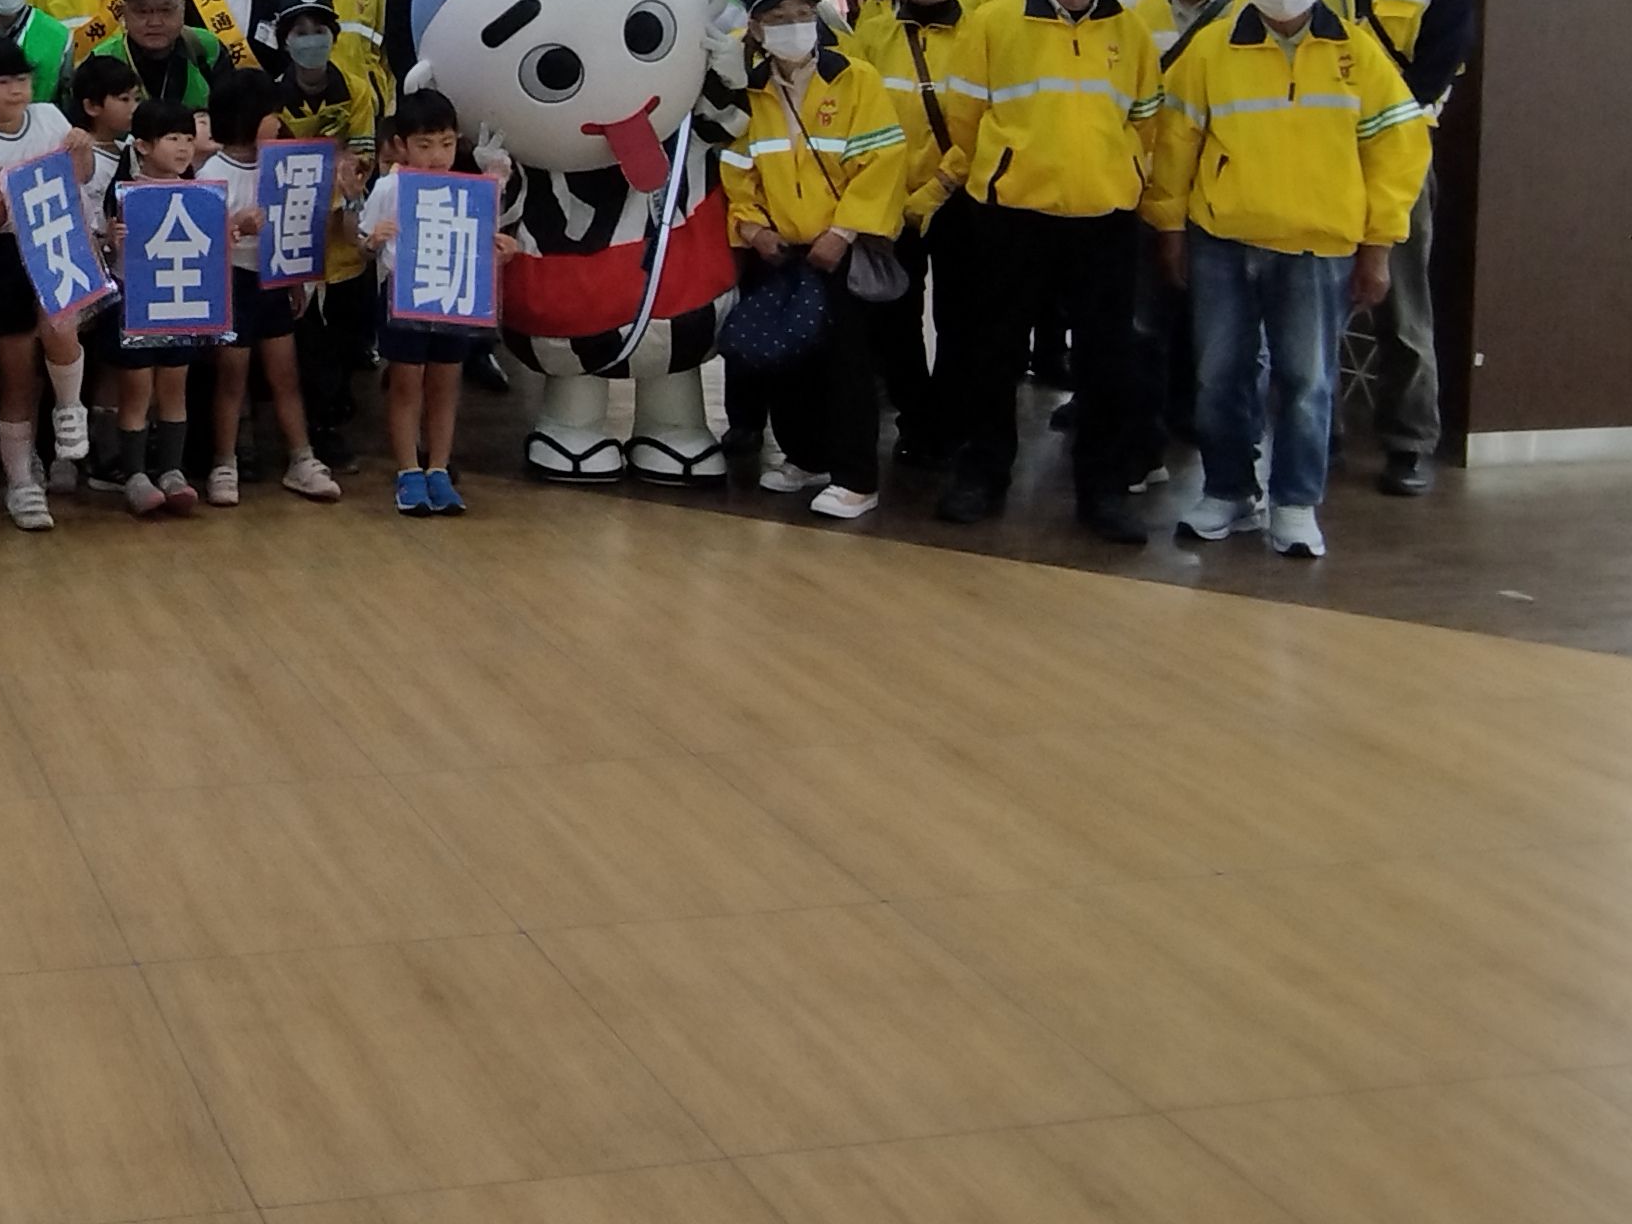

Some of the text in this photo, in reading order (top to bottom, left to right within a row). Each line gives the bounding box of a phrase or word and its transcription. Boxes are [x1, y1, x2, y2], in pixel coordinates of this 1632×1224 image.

[21, 172, 92, 310] 安
[144, 192, 213, 322] 全
[268, 153, 325, 276] 運
[412, 185, 479, 316] 動
